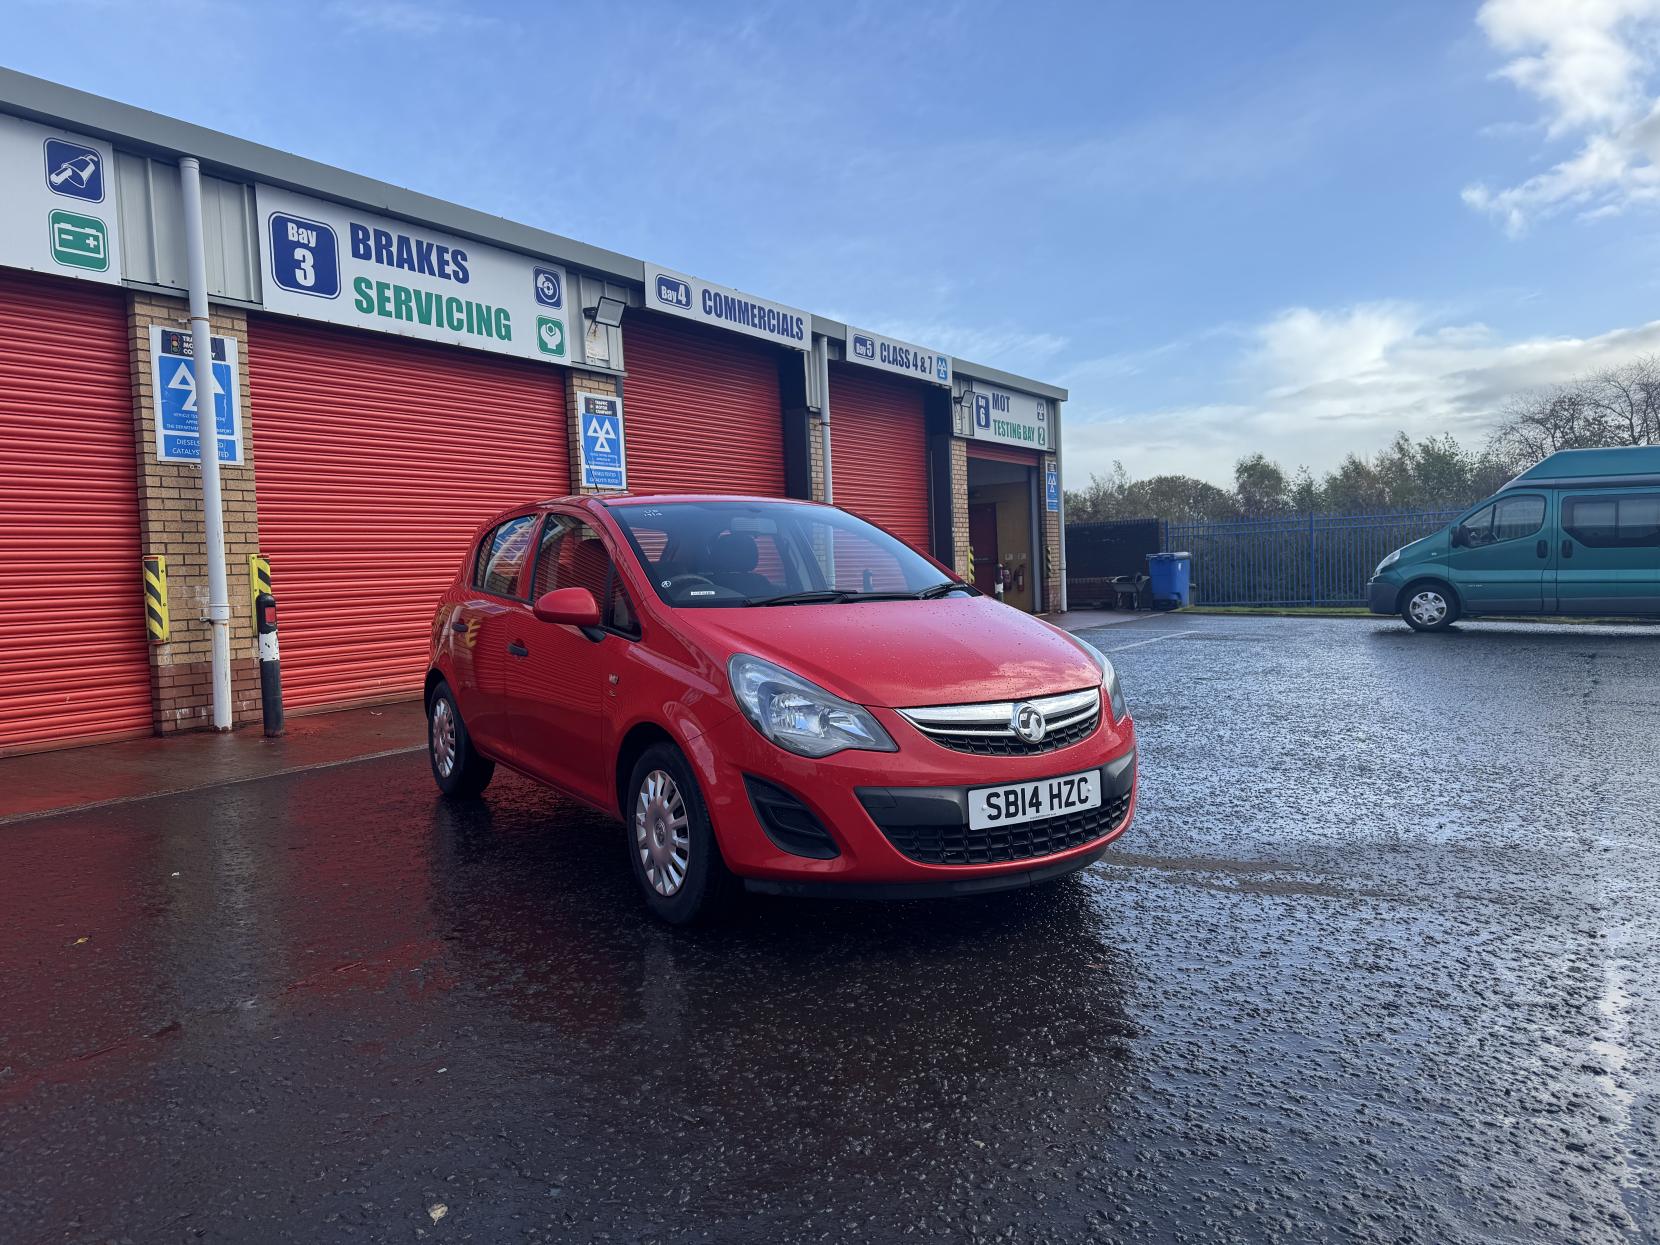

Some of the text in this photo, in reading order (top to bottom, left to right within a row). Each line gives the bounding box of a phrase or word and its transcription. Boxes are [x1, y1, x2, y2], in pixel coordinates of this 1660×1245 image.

[287, 222, 317, 248] Bay
[293, 248, 316, 287] 3
[349, 222, 470, 285] BRAKES
[353, 276, 513, 342] SERVICING
[661, 284, 687, 306] Bay 4
[701, 288, 804, 342] COMMERCIALS
[866, 340, 872, 357] 5
[880, 342, 933, 375] CLASS 4 & 7
[980, 407, 986, 426] 6
[992, 392, 1011, 413] MOT
[993, 419, 1022, 440] TESTING
[1022, 424, 1036, 443] BAY
[985, 776, 1090, 821] SB14 HZC
